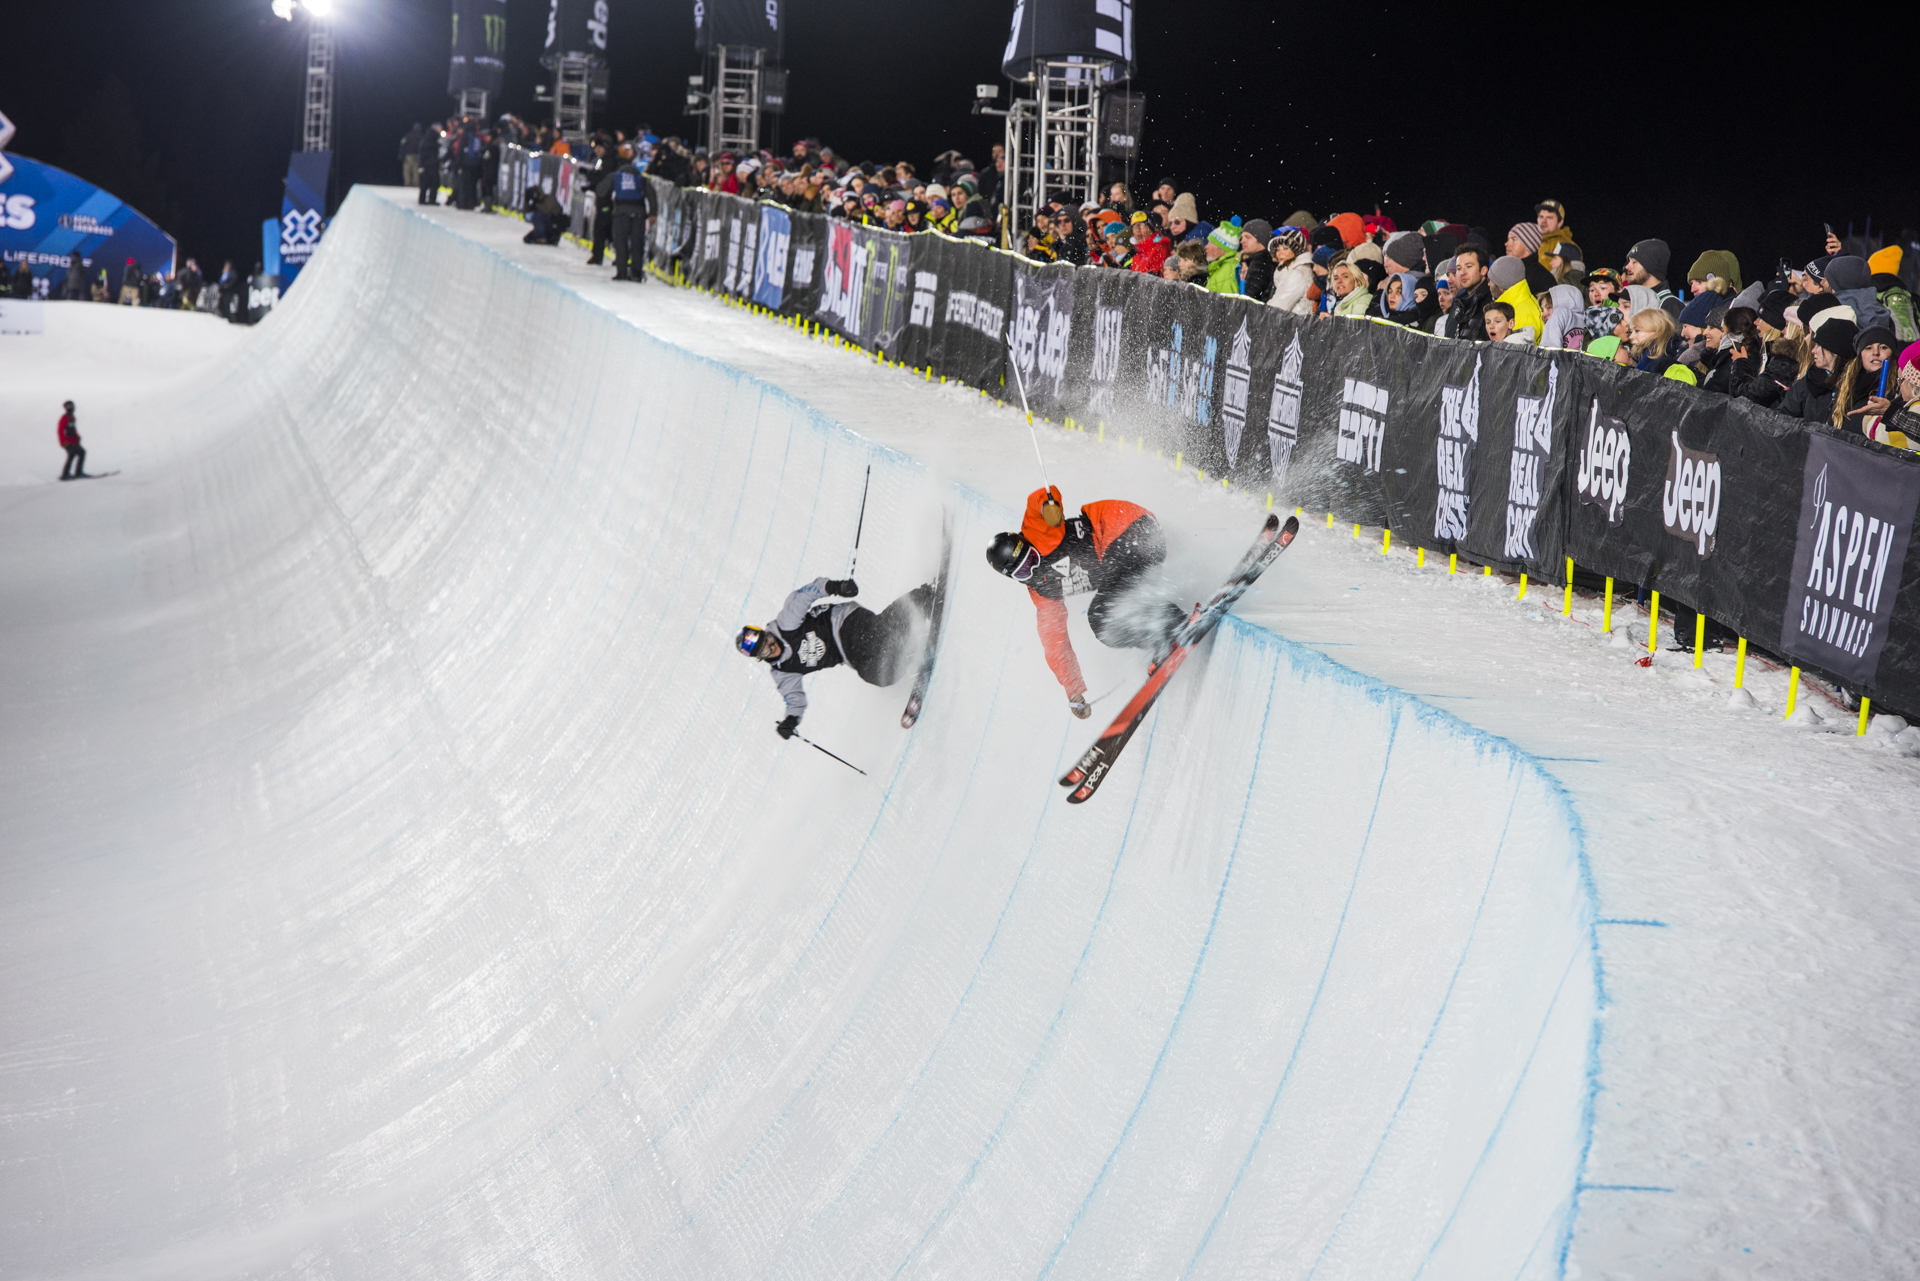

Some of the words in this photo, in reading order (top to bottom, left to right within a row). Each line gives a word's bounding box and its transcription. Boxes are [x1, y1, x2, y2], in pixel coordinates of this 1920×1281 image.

[4, 249, 93, 268] LIFEPROF
[1577, 398, 1631, 523] Jeep
[1662, 430, 1722, 556] Jeep
[1806, 501, 1896, 614] ASPEN
[1800, 595, 1874, 659] SNOWMASS
[1084, 761, 1110, 791] head
